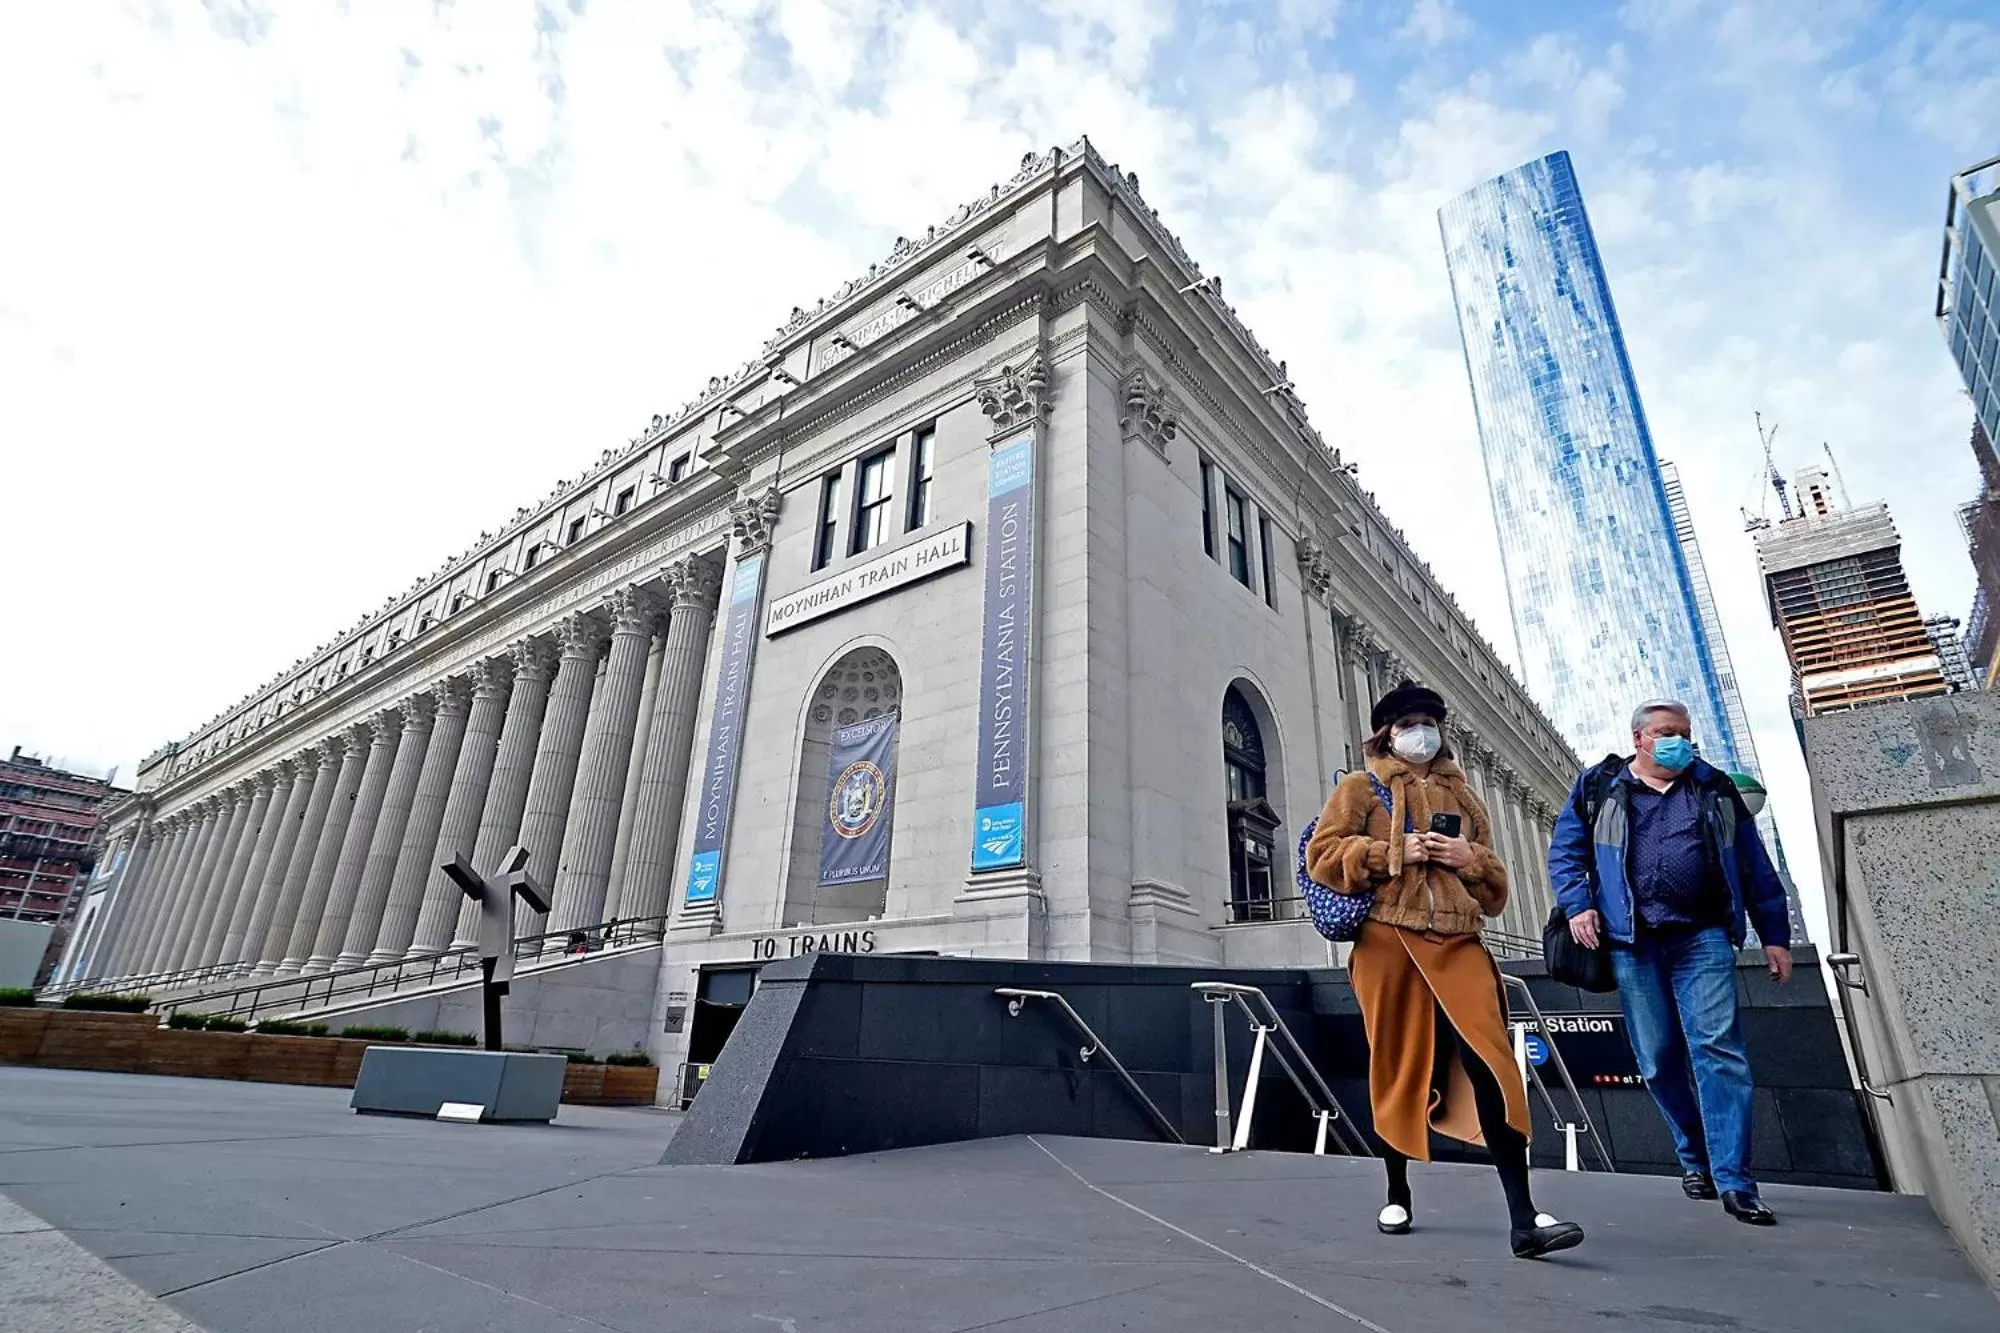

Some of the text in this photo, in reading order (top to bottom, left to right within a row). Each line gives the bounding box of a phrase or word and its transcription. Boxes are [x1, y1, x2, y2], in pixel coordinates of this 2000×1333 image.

[771, 580, 852, 623] MOYNIHAN
[858, 558, 908, 588] TRAIN
[915, 538, 960, 567] HALL
[993, 502, 1018, 788] PENNSYLVANIA STATION
[705, 725, 730, 839] MOYNIHAN
[721, 660, 740, 720] TRAIN
[732, 608, 747, 656] HALL
[752, 931, 874, 959] TO TRAINS
[1546, 1017, 1614, 1032] Station
[1526, 1042, 1541, 1059] E
[1623, 1075, 1633, 1084] at
[1635, 1075, 1642, 1084] 7
